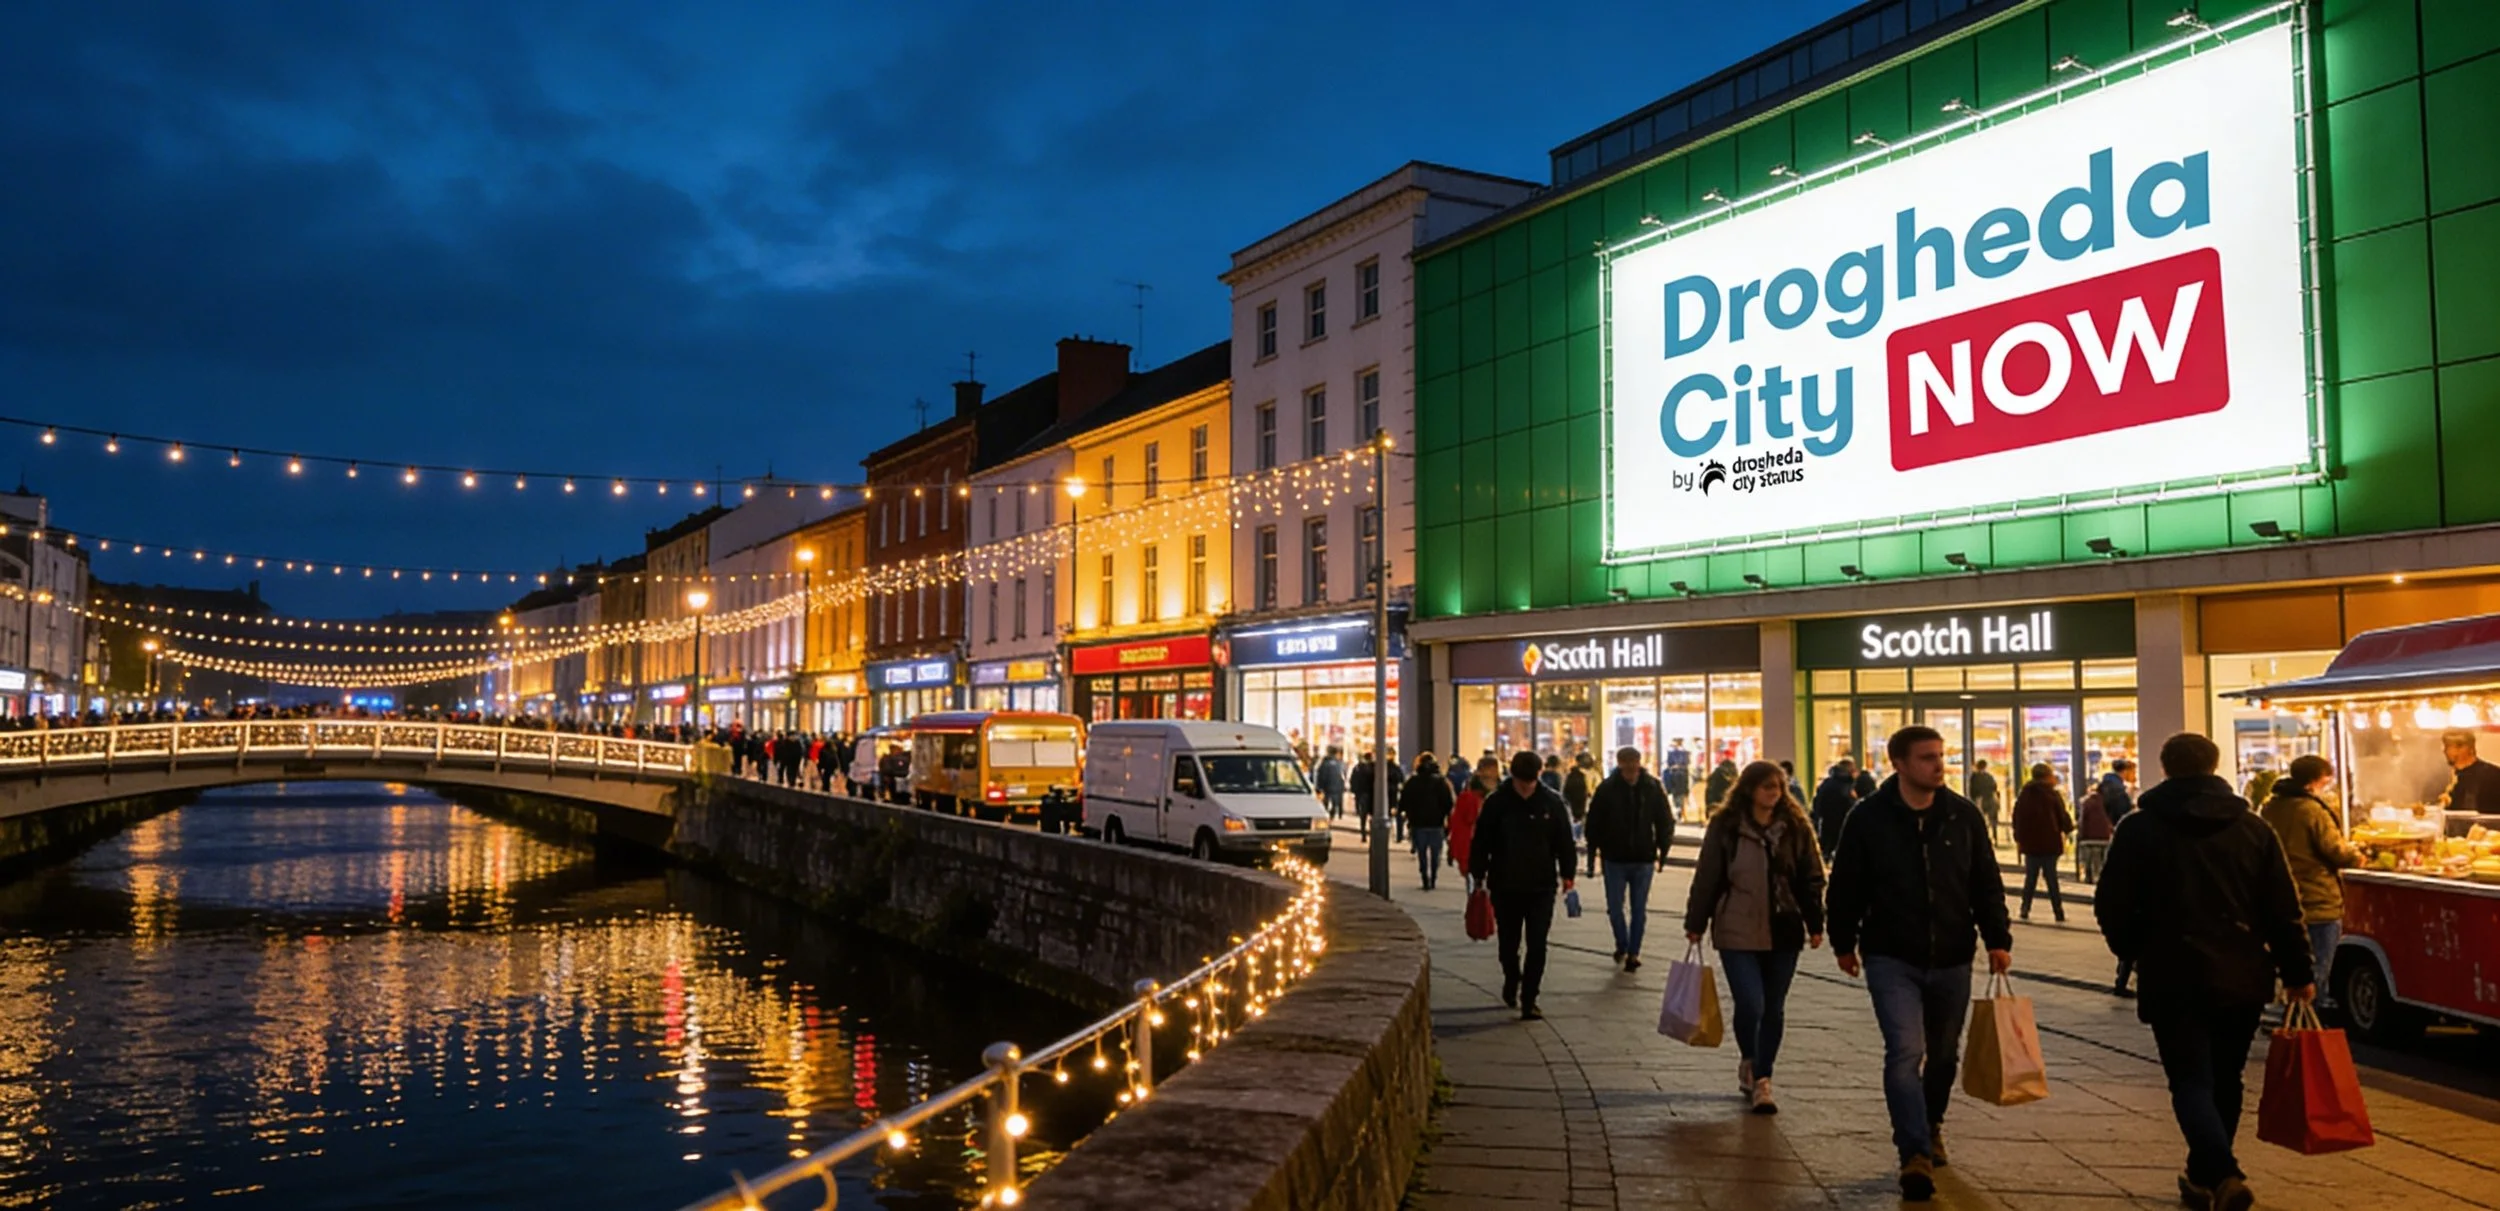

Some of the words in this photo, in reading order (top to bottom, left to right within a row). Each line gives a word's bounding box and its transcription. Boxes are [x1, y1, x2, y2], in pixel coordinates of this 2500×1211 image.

[1663, 147, 2211, 359] Drogheda
[1660, 364, 1854, 458] City
[1907, 280, 2204, 436] NOW
[1672, 470, 1694, 492] by
[1732, 446, 1804, 474] drogheda
[1612, 633, 1663, 669] Hall
[1861, 617, 1972, 660] Scotch
[1982, 610, 2053, 654] Hall
